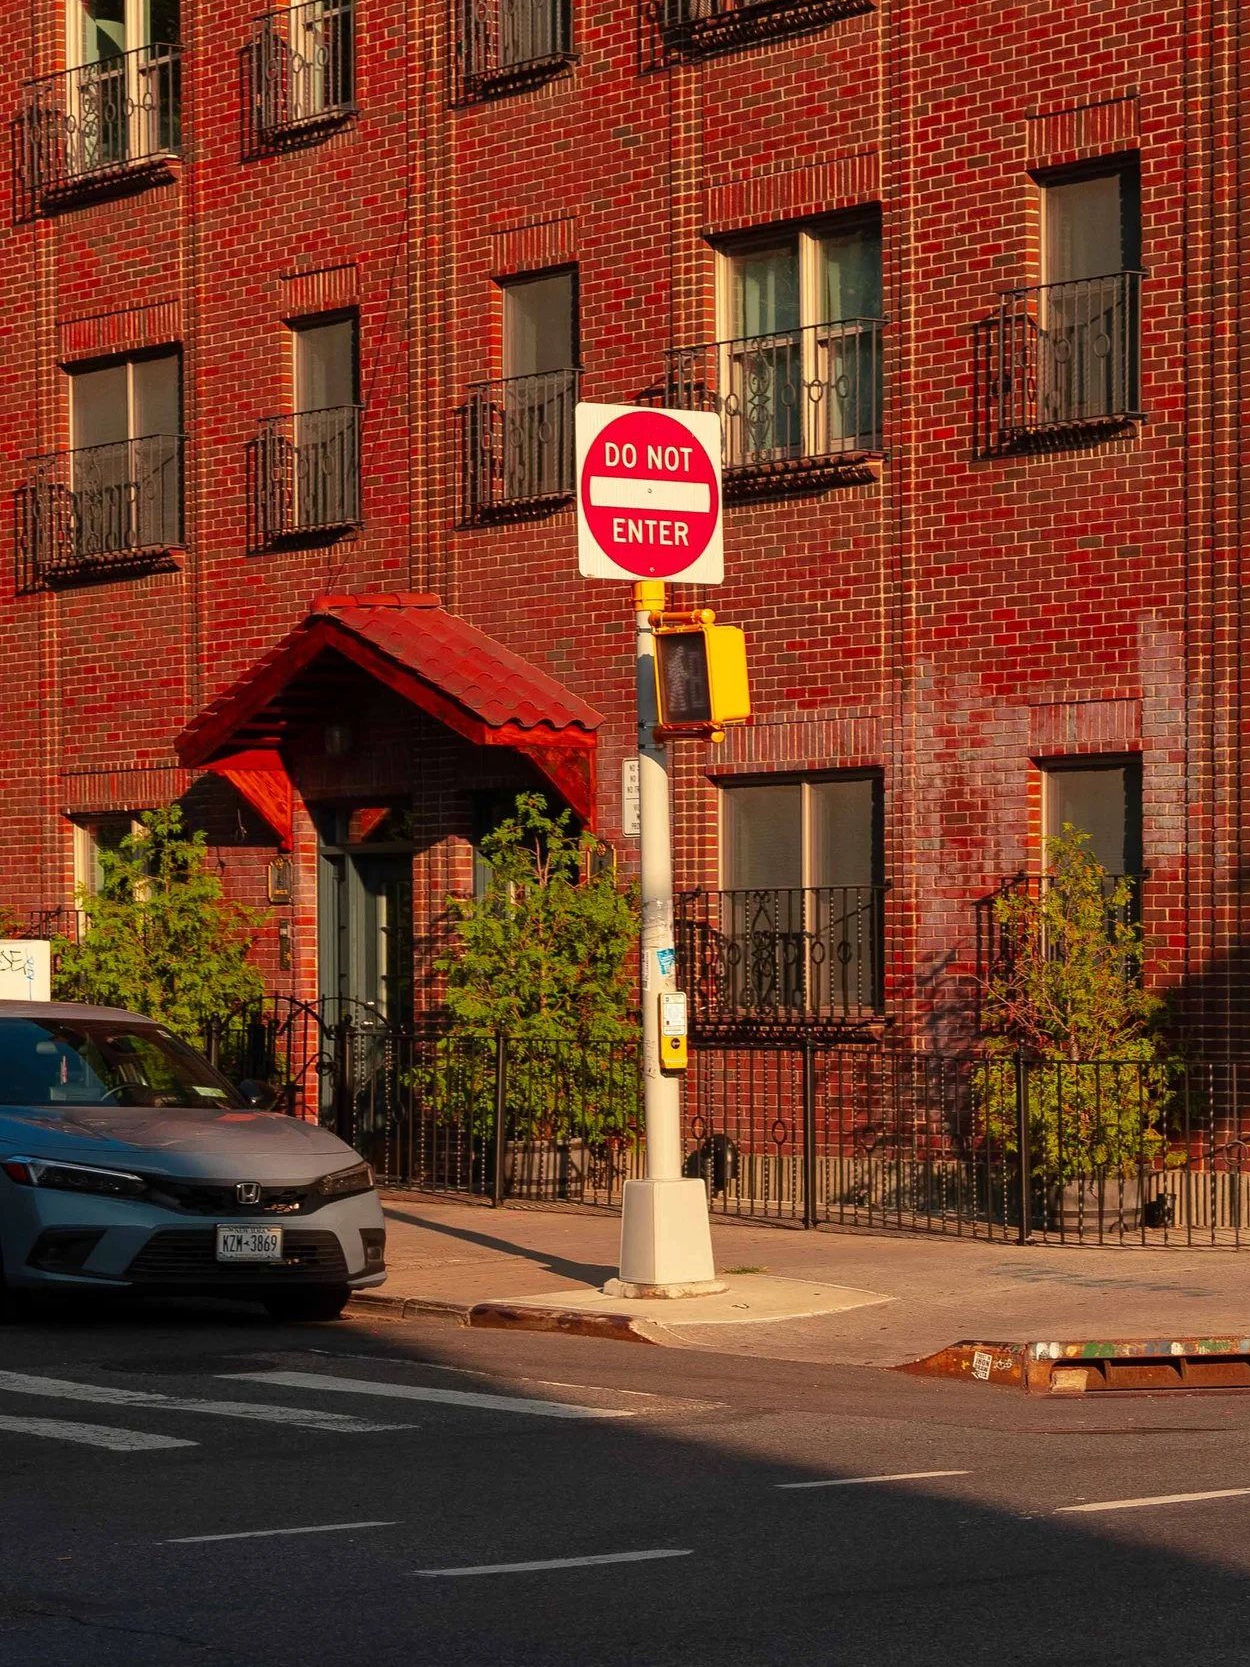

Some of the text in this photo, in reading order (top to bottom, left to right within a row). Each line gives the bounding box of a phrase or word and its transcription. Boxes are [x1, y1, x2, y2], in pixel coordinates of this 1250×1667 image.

[604, 441, 693, 472] DO NOT
[612, 517, 689, 547] ENTER
